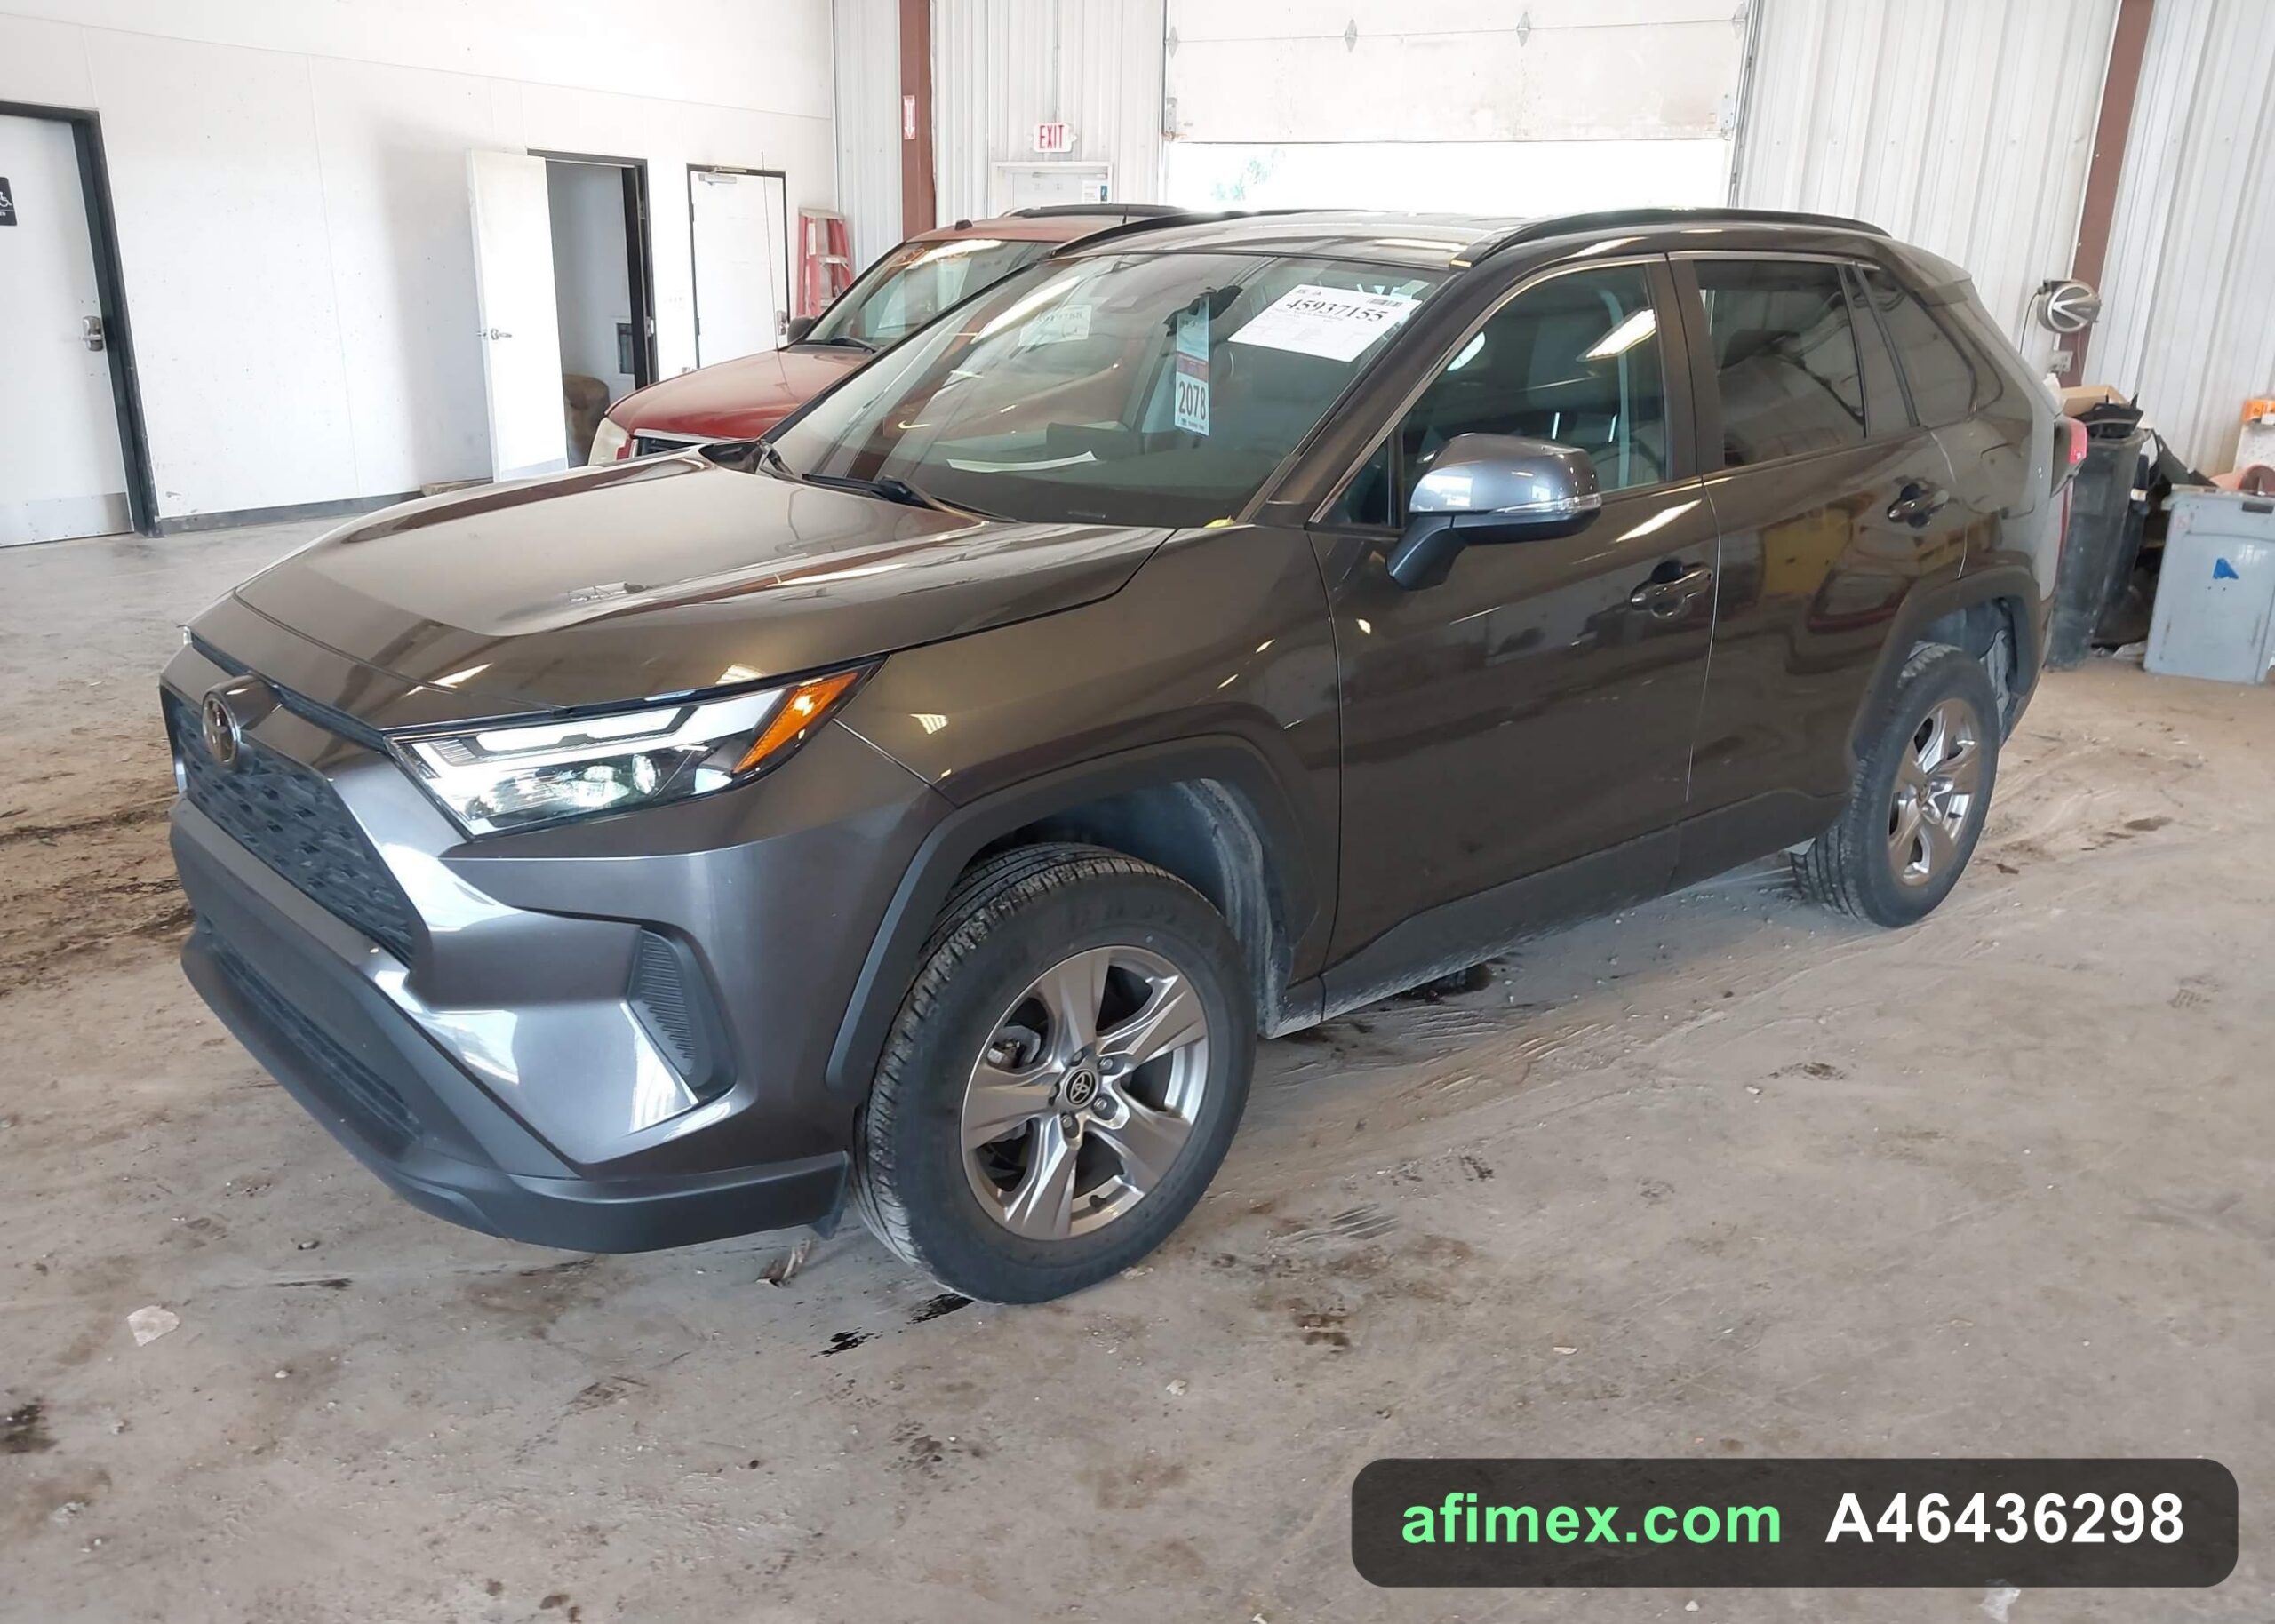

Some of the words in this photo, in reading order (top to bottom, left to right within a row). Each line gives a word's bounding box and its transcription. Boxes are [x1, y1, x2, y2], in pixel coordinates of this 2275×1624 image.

[1039, 125, 1064, 148] EXIT
[1286, 299, 1388, 322] 45937155
[1178, 380, 1206, 421] 2078
